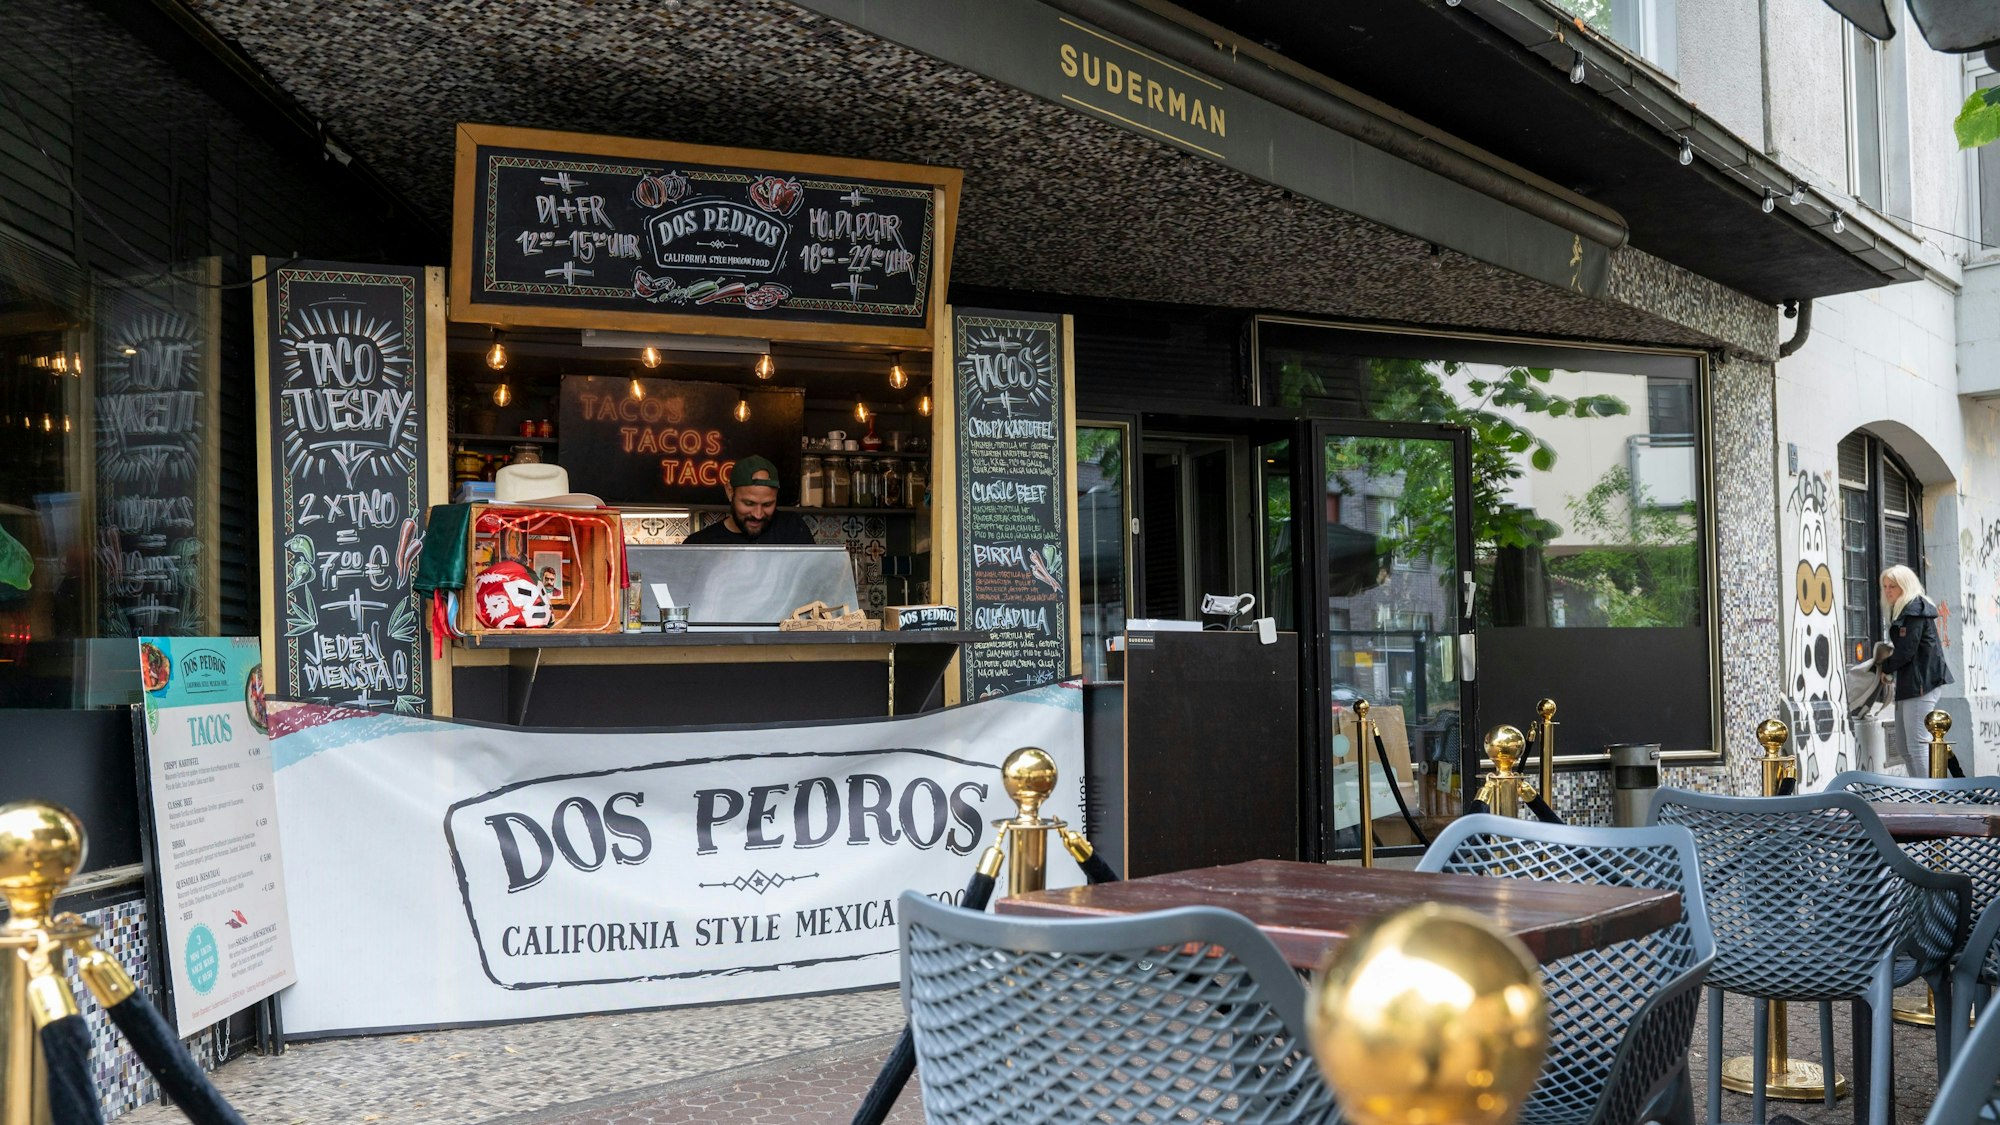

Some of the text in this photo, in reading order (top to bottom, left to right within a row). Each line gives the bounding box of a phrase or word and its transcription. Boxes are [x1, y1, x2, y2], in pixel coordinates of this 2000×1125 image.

[1060, 43, 1226, 137] SUDERMAN
[658, 207, 781, 247] DOS PEDROS
[607, 232, 642, 260] UHR
[663, 253, 707, 264] CALIFORNIA
[709, 255, 727, 264] STYLE
[752, 258, 770, 267] FOOD
[884, 249, 915, 285] UHR
[296, 336, 378, 388] TACO
[967, 347, 1037, 391] TACOS
[281, 388, 412, 448] TUESDAY
[580, 395, 685, 423] TACOS
[620, 427, 722, 454] TACOS
[968, 417, 1055, 440] CRISPY KARTOFFEL
[662, 459, 736, 486] TACO
[972, 480, 1047, 504] CLASSIC BEEF
[299, 493, 323, 525] 2
[342, 489, 398, 529] TACO
[973, 544, 1030, 571] BIRRIA
[899, 611, 918, 628] DOS
[975, 604, 1051, 636] QUESADILLA
[305, 621, 385, 665] JEDEN
[184, 655, 226, 676] DOS PEDROS
[303, 650, 408, 692] DIENSTAG
[187, 713, 233, 747] TACOS
[163, 757, 199, 770] CRISPY KARTOFFEL
[168, 799, 182, 810] CLASSIC
[184, 797, 193, 807] BEEF
[484, 773, 989, 895] DOS PEDROS
[176, 875, 199, 890] QUESADILLA
[183, 910, 193, 921] BEEF
[501, 920, 680, 958] CALIFORNIA
[695, 912, 782, 947] STYLE
[795, 898, 900, 938] MEXICA
[196, 934, 202, 945] 3
